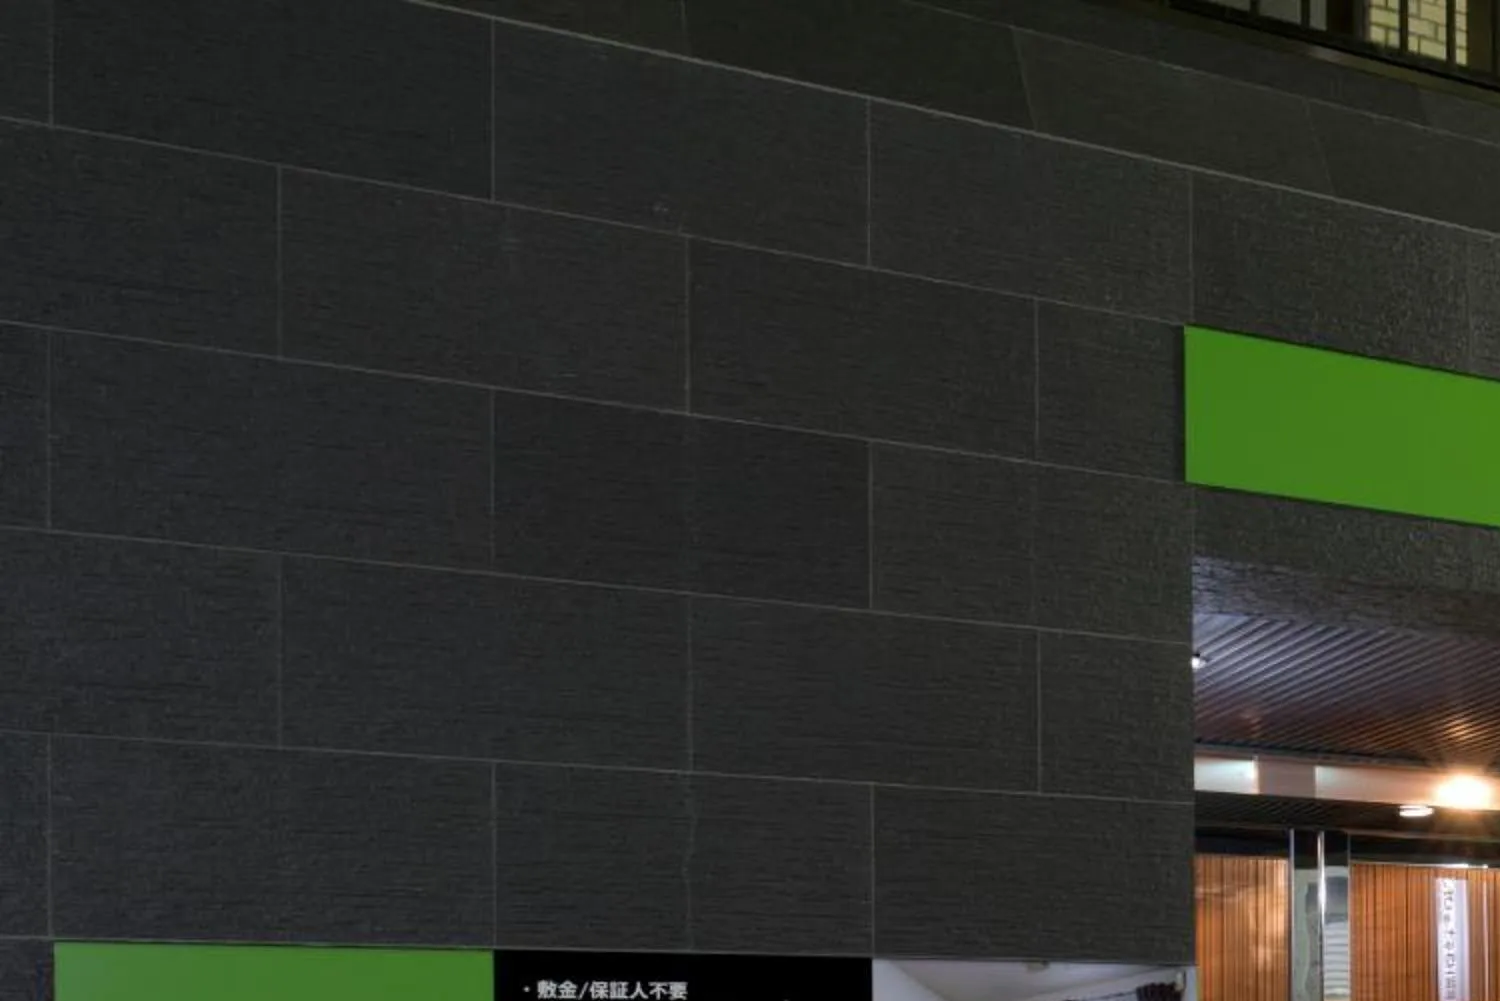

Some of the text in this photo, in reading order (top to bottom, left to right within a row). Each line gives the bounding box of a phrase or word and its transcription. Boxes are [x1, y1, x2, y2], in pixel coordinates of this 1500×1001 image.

[537, 980, 688, 1000] 敷金/保証人不要
